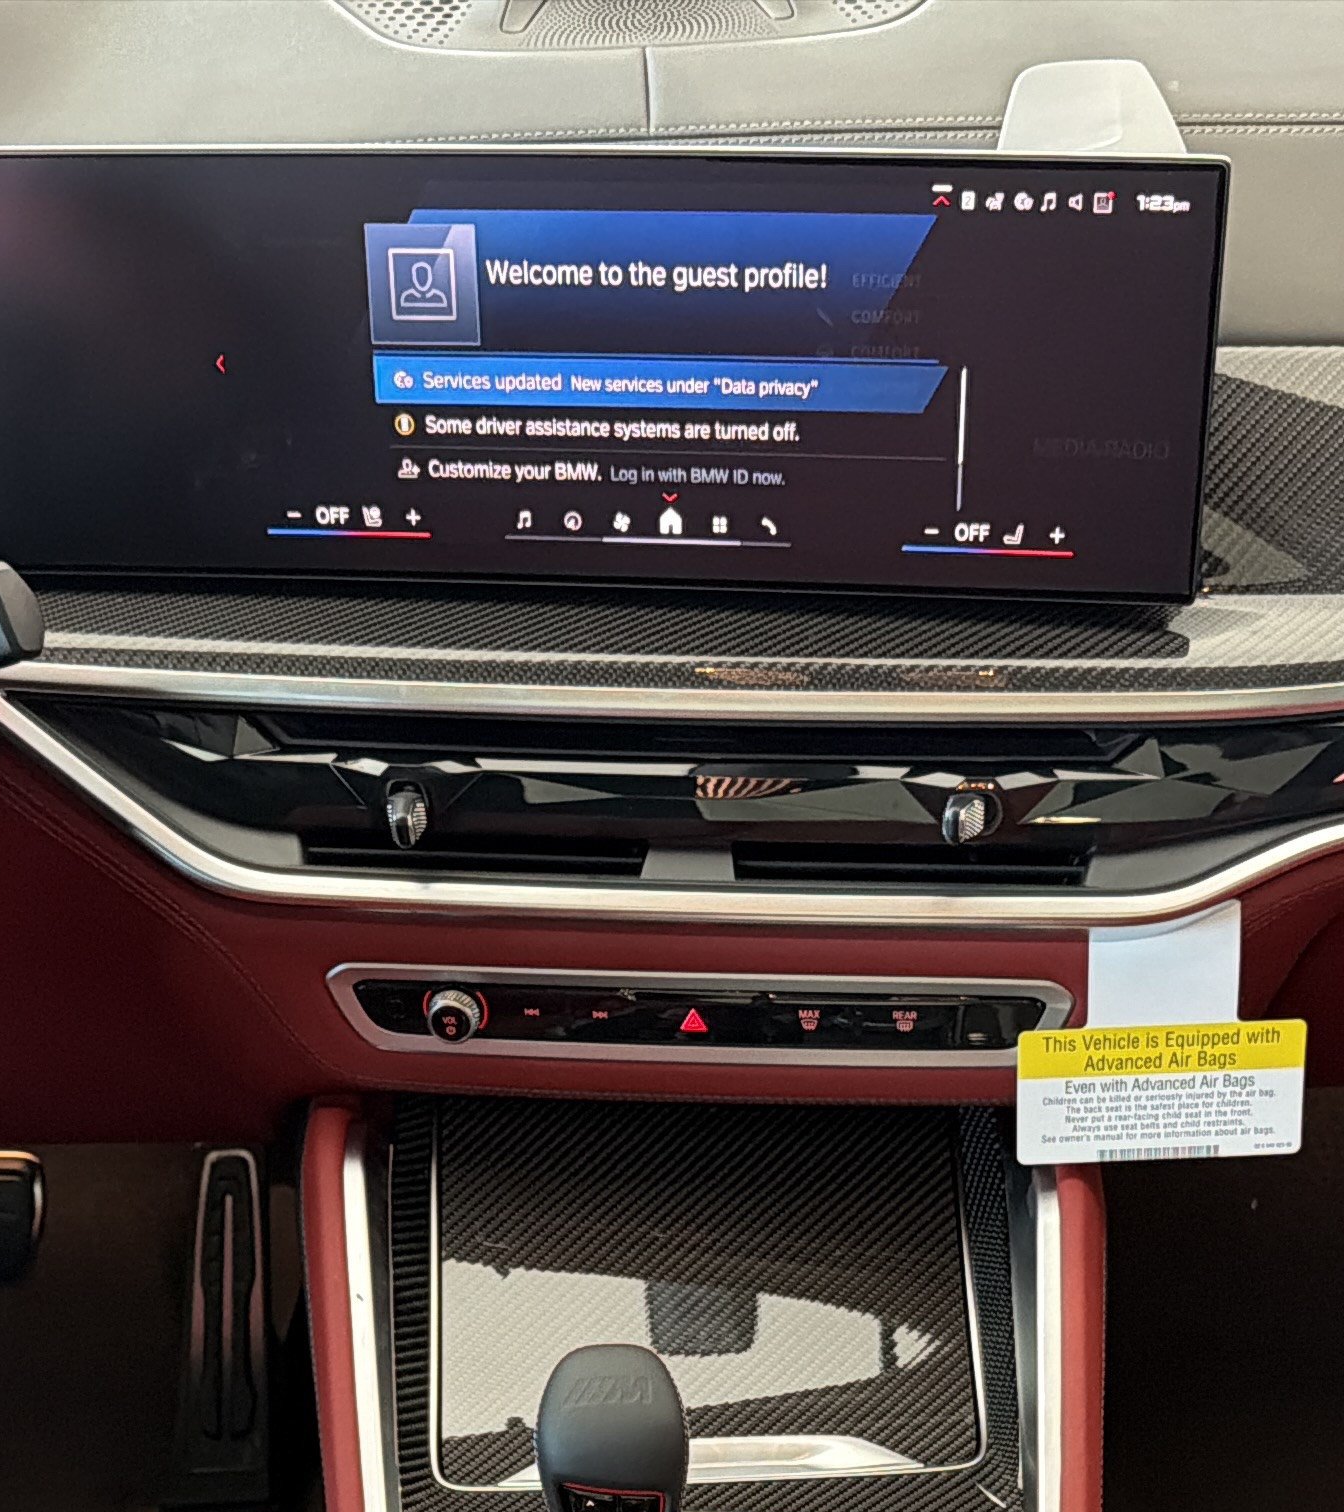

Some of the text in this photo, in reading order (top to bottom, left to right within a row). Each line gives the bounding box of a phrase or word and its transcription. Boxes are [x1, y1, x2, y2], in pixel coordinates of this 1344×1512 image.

[485, 259, 828, 292] Welcome to the guest profile!
[422, 371, 818, 399] Services updated New services under "Data privacy"
[425, 414, 801, 442] Some driver assistance systems are turned off.
[428, 459, 786, 486] Customize your BMW. Log in with BMW ID now.
[315, 505, 350, 525] OFF
[954, 522, 991, 542] OFF
[798, 1009, 821, 1020] MAX
[892, 1011, 918, 1021] REAR
[1042, 1027, 1281, 1053] This Vehicle is Equipped with
[1084, 1050, 1237, 1072] Advanced Air Bags
[1065, 1073, 1256, 1095] Even with Advanced Air Bags
[1042, 1096, 1077, 1106] Children
[1080, 1097, 1094, 1105] can
[1096, 1095, 1107, 1104] be
[1145, 1092, 1183, 1102] seriously
[1185, 1090, 1215, 1100] injured
[1217, 1090, 1228, 1100] by
[1230, 1089, 1243, 1098] the
[1245, 1089, 1256, 1098] air
[1066, 1105, 1081, 1114] The
[1084, 1104, 1102, 1113] back
[1105, 1104, 1122, 1113] seat
[1125, 1104, 1132, 1112] is
[1135, 1103, 1147, 1111] the
[1150, 1102, 1175, 1111] safest
[1177, 1101, 1199, 1110] place
[1202, 1100, 1214, 1109] for
[1065, 1115, 1088, 1124] Never
[1091, 1114, 1104, 1124] put
[1162, 1110, 1182, 1120] child
[1184, 1110, 1202, 1119] seat
[1204, 1109, 1212, 1118] in
[1215, 1109, 1228, 1118] the
[1072, 1123, 1101, 1133] Always
[1120, 1123, 1137, 1131] seat
[1140, 1121, 1160, 1130] belts
[1163, 1121, 1178, 1129] and
[1180, 1119, 1200, 1128] child
[1041, 1134, 1057, 1143] See
[1094, 1131, 1123, 1141] manual
[1125, 1131, 1138, 1140] for
[1140, 1131, 1161, 1140] more
[1164, 1128, 1212, 1139] information
[1214, 1127, 1238, 1136] about
[1240, 1127, 1251, 1135] air
